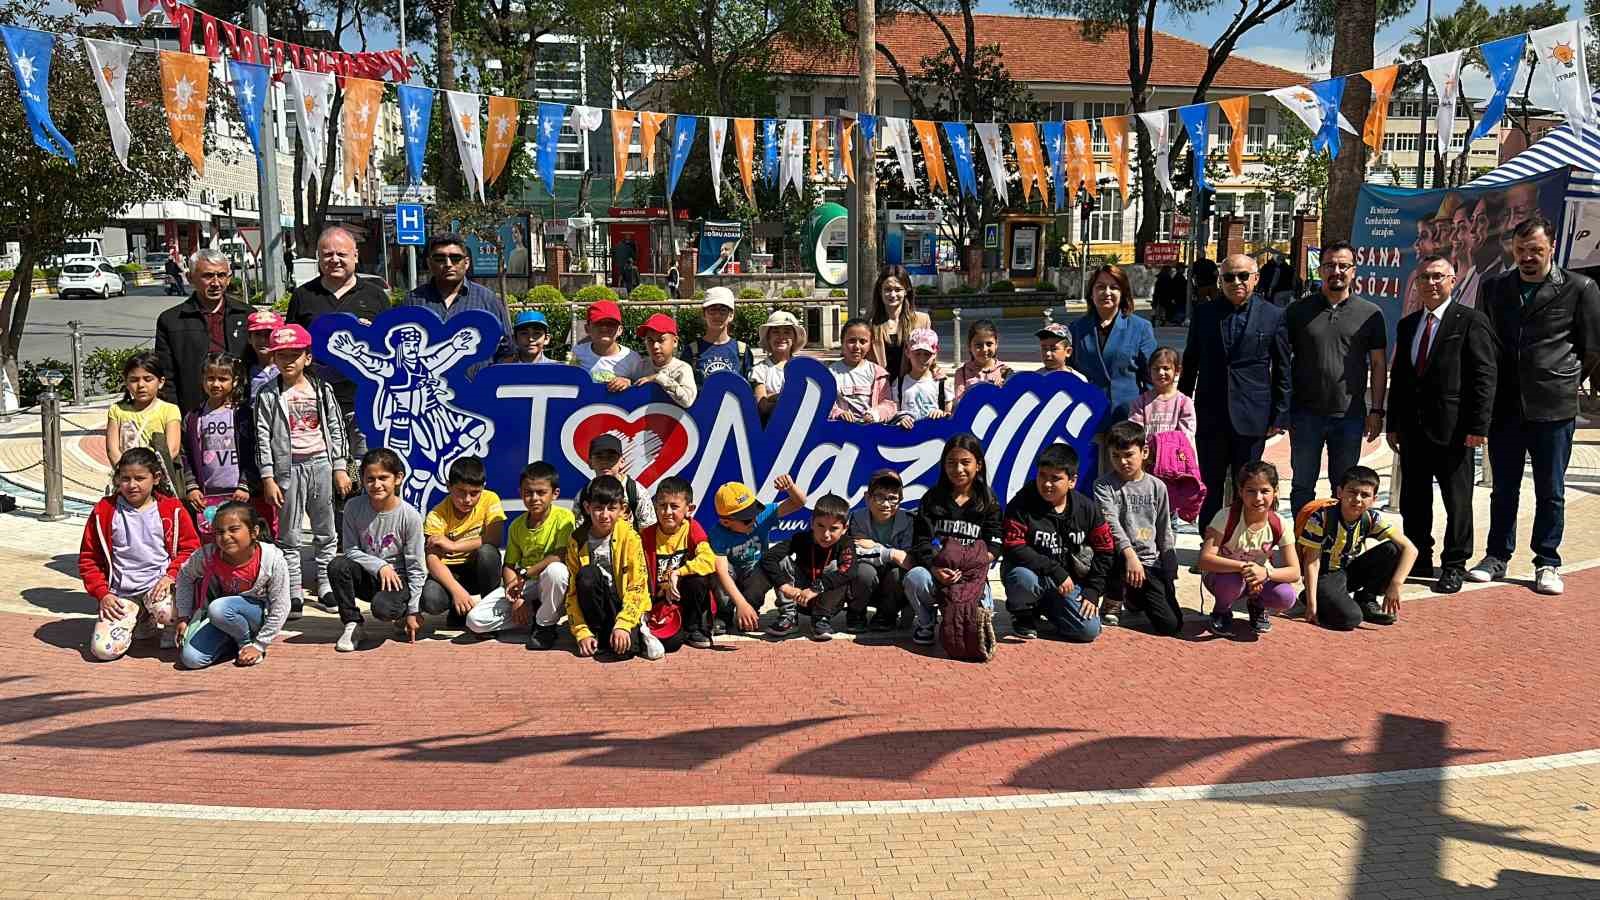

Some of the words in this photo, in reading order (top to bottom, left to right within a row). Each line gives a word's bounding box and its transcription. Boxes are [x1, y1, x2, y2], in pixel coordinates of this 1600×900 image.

[402, 209, 418, 229] H
[1356, 246, 1400, 268] SANA
[1354, 272, 1399, 298] SÖZ!
